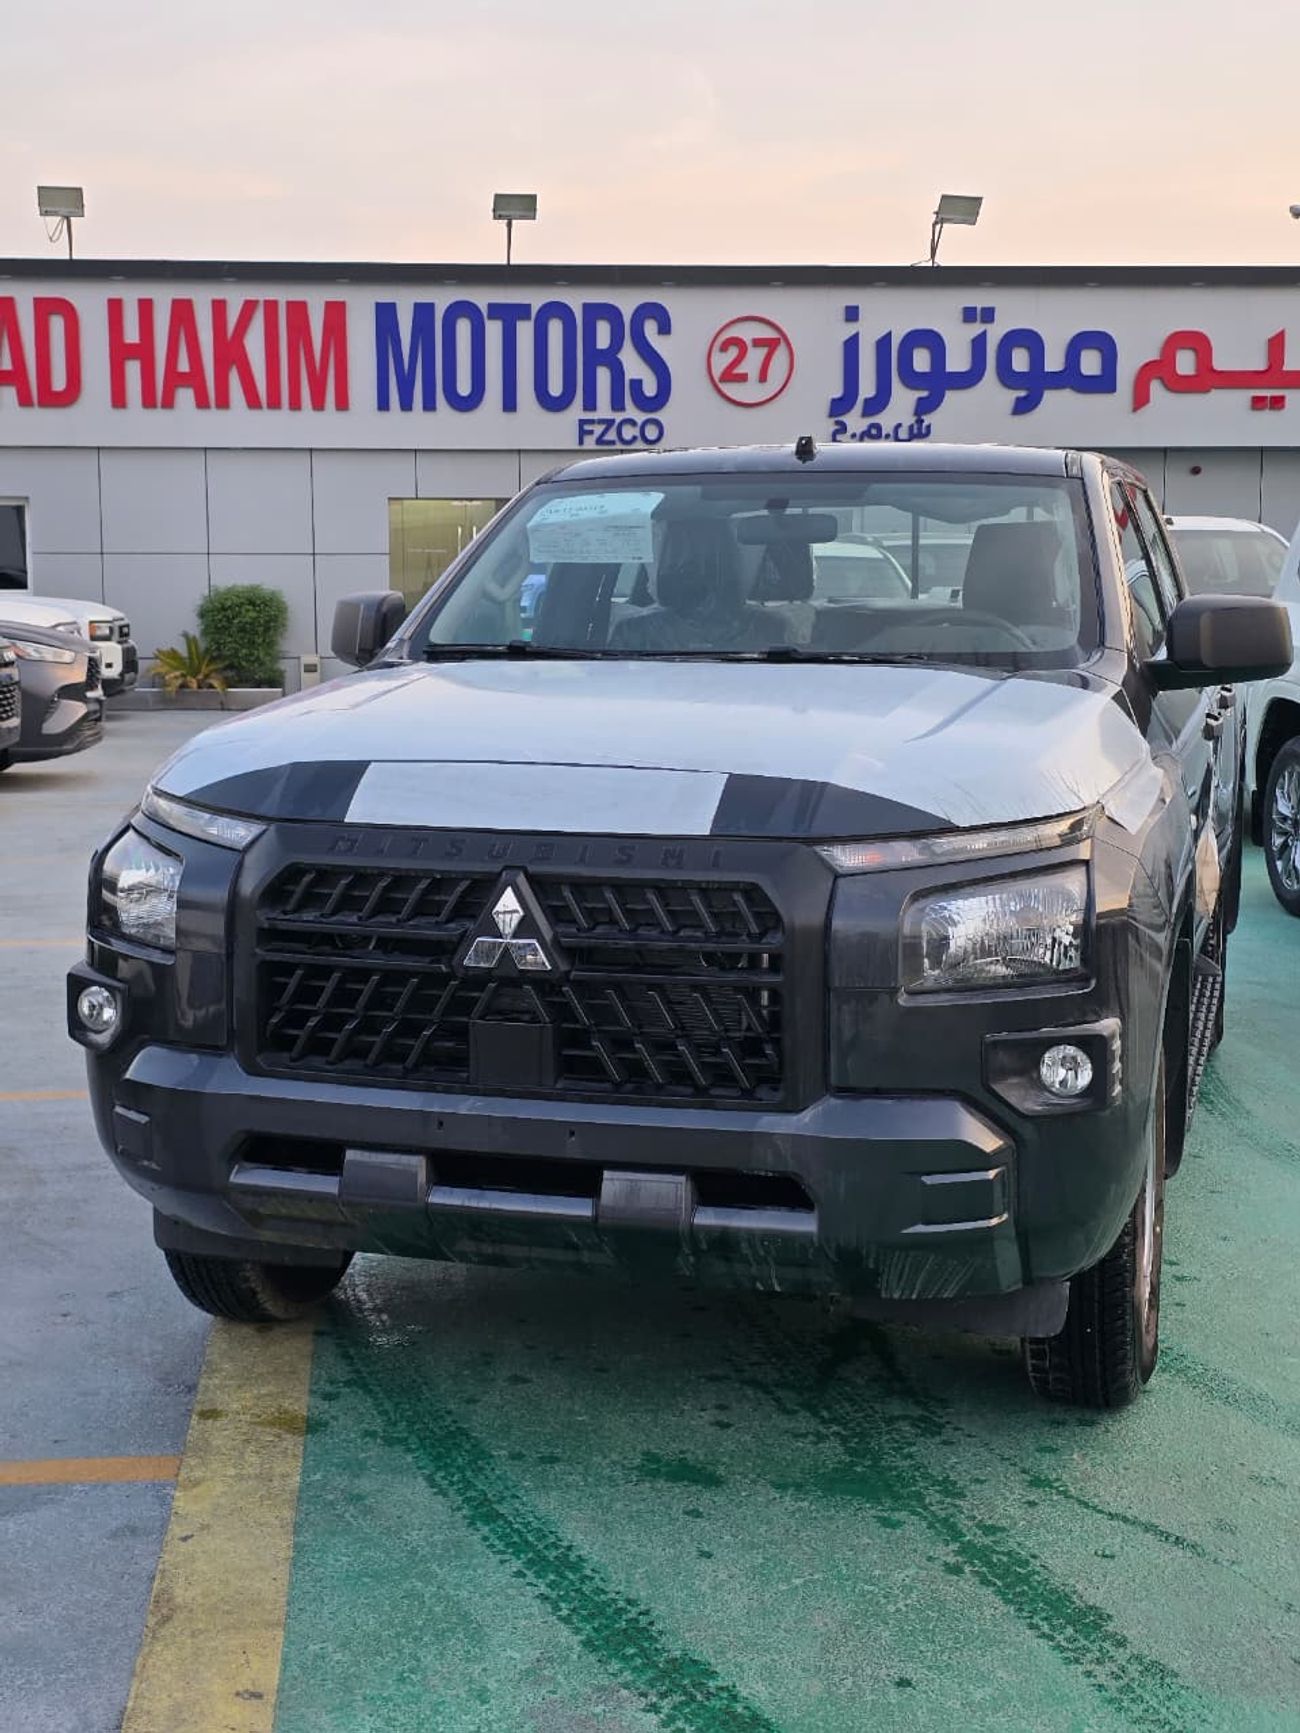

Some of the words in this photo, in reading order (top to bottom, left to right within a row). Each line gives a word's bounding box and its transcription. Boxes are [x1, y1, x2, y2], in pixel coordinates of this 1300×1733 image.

[0, 296, 82, 408] AD
[107, 297, 349, 411] HAKIM
[374, 299, 672, 413] MOTORS
[718, 336, 782, 384] 27
[828, 304, 1118, 418] موتورز
[577, 417, 665, 446] FZCO
